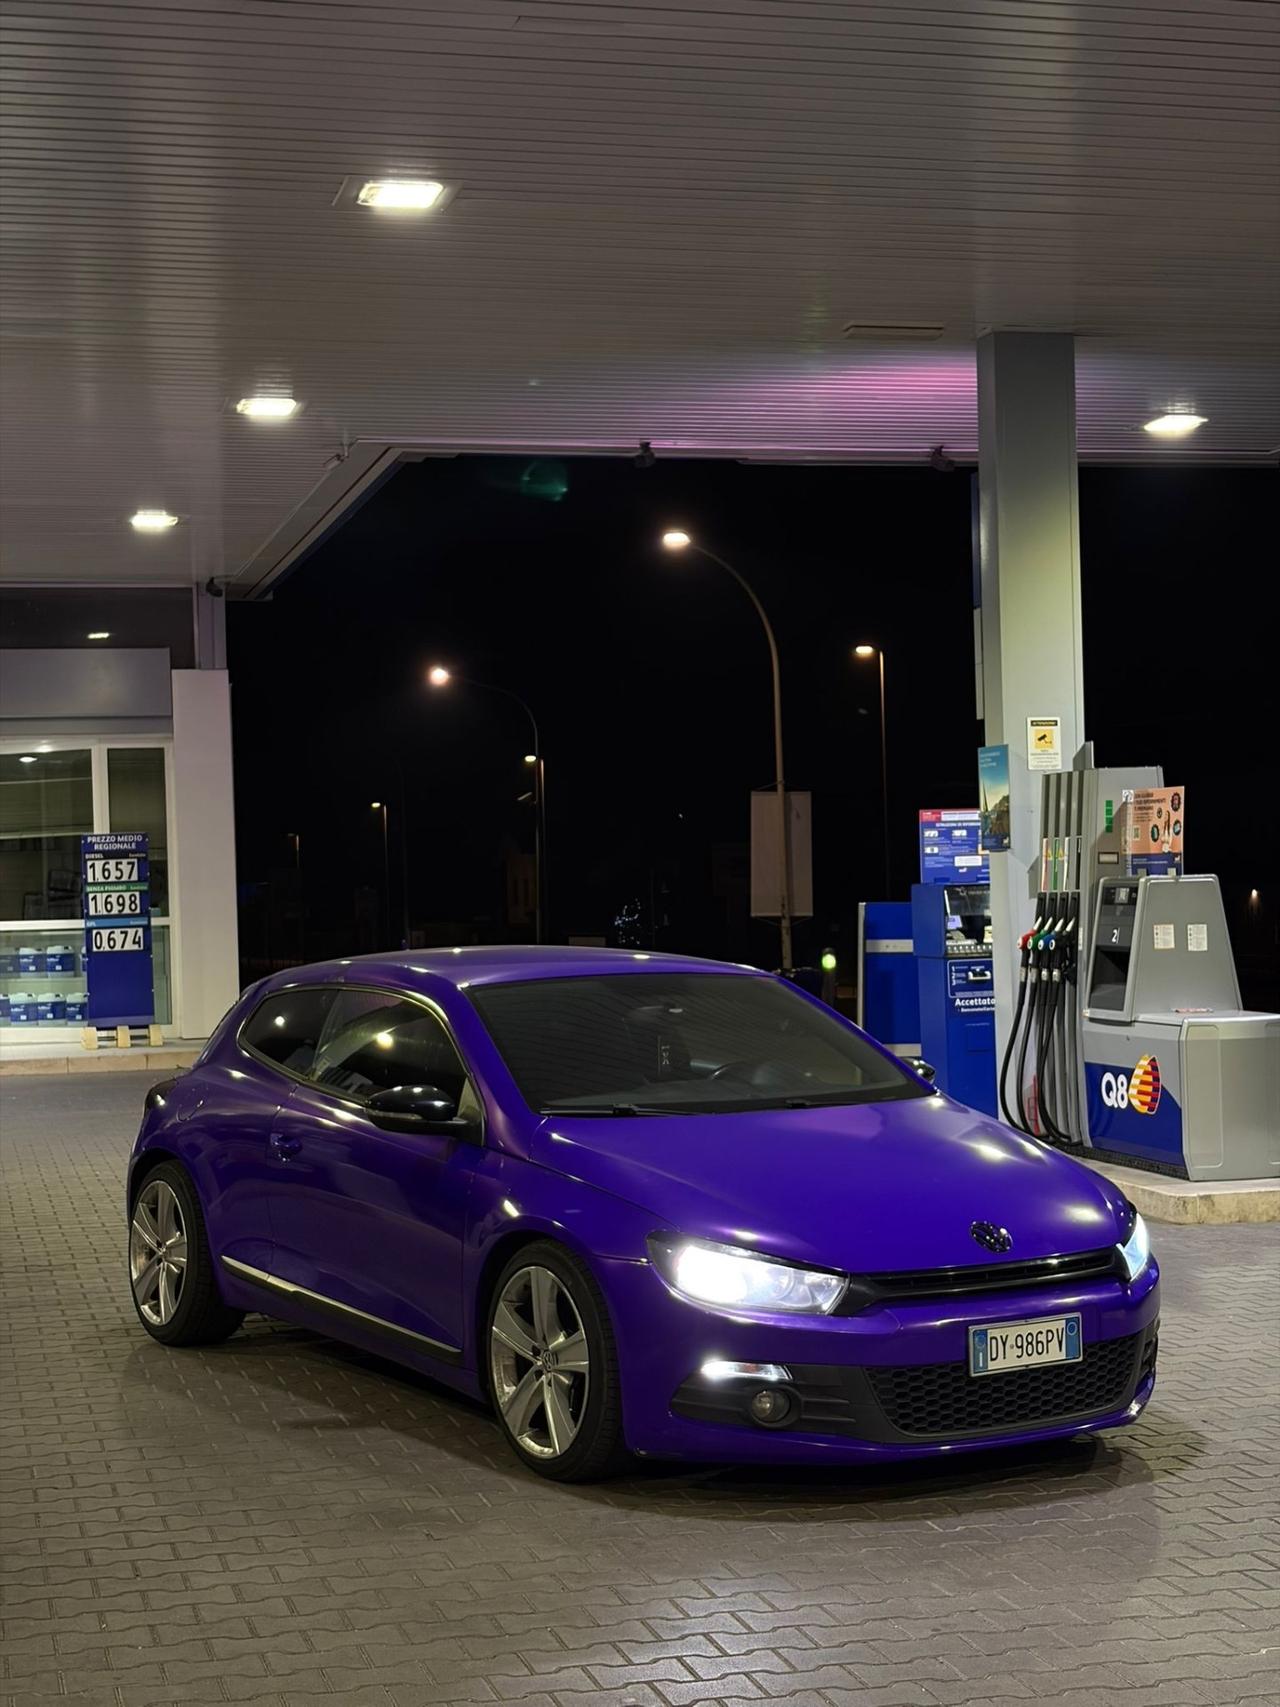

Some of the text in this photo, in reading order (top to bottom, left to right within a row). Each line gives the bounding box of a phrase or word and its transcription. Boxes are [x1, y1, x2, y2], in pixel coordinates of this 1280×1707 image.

[87, 834, 142, 843] PREZZO MEDIO
[94, 842, 136, 850] REGIONALE
[1101, 1071, 1129, 1110] Q8
